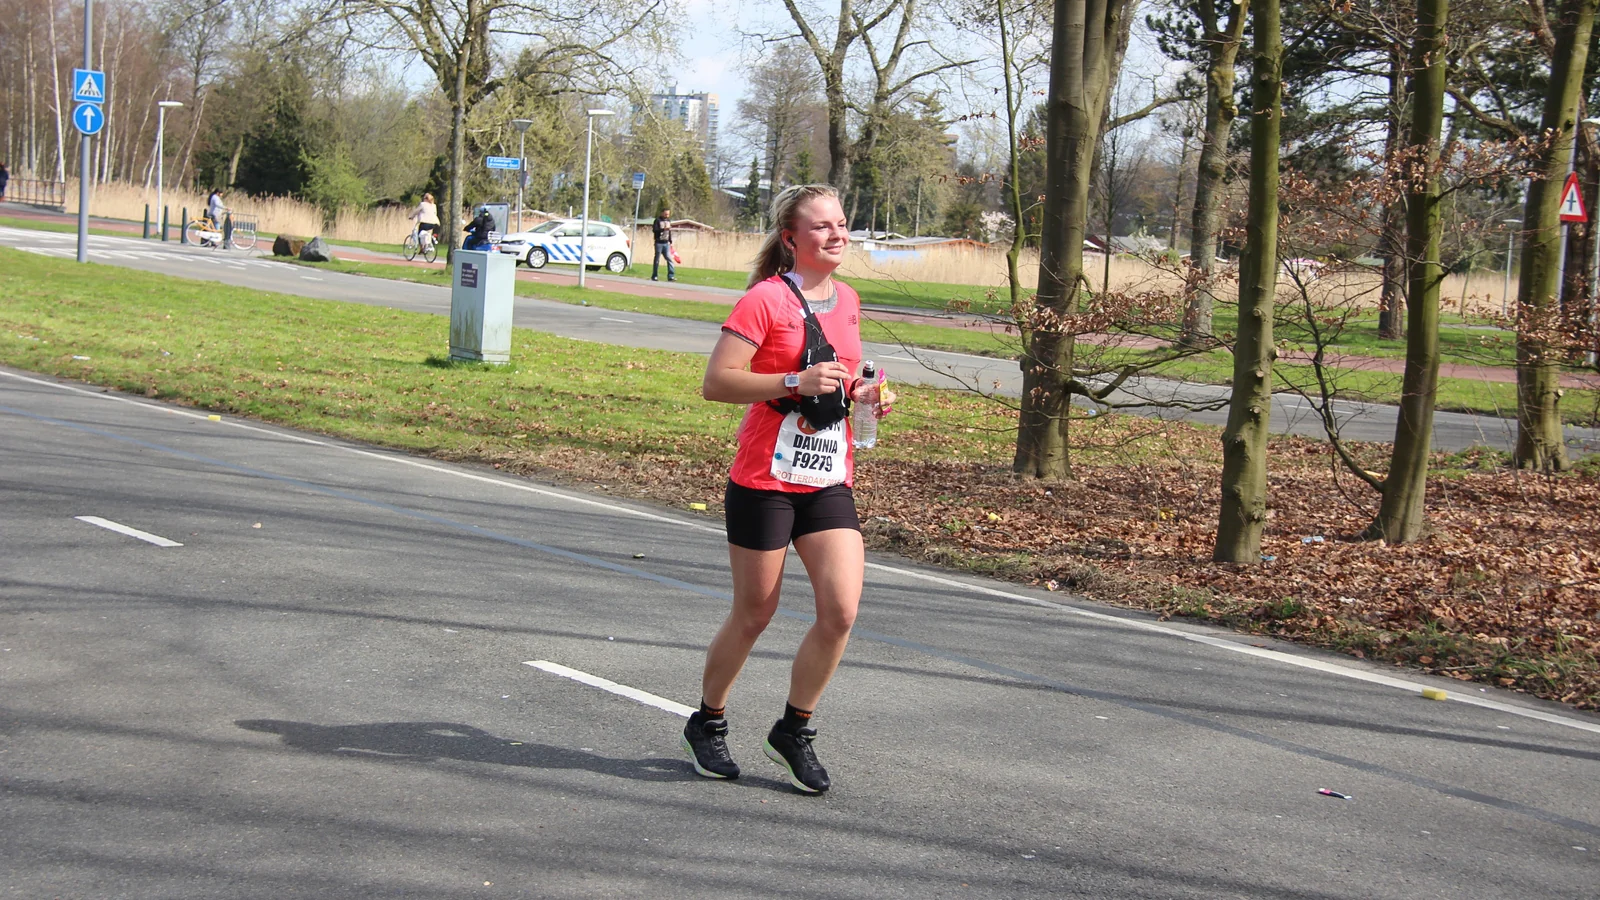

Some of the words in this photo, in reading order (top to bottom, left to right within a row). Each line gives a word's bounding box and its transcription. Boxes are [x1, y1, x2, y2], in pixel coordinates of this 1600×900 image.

[793, 434, 838, 454] DAVINIA
[792, 451, 833, 472] F9279
[775, 470, 825, 485] ROTTERDAM
